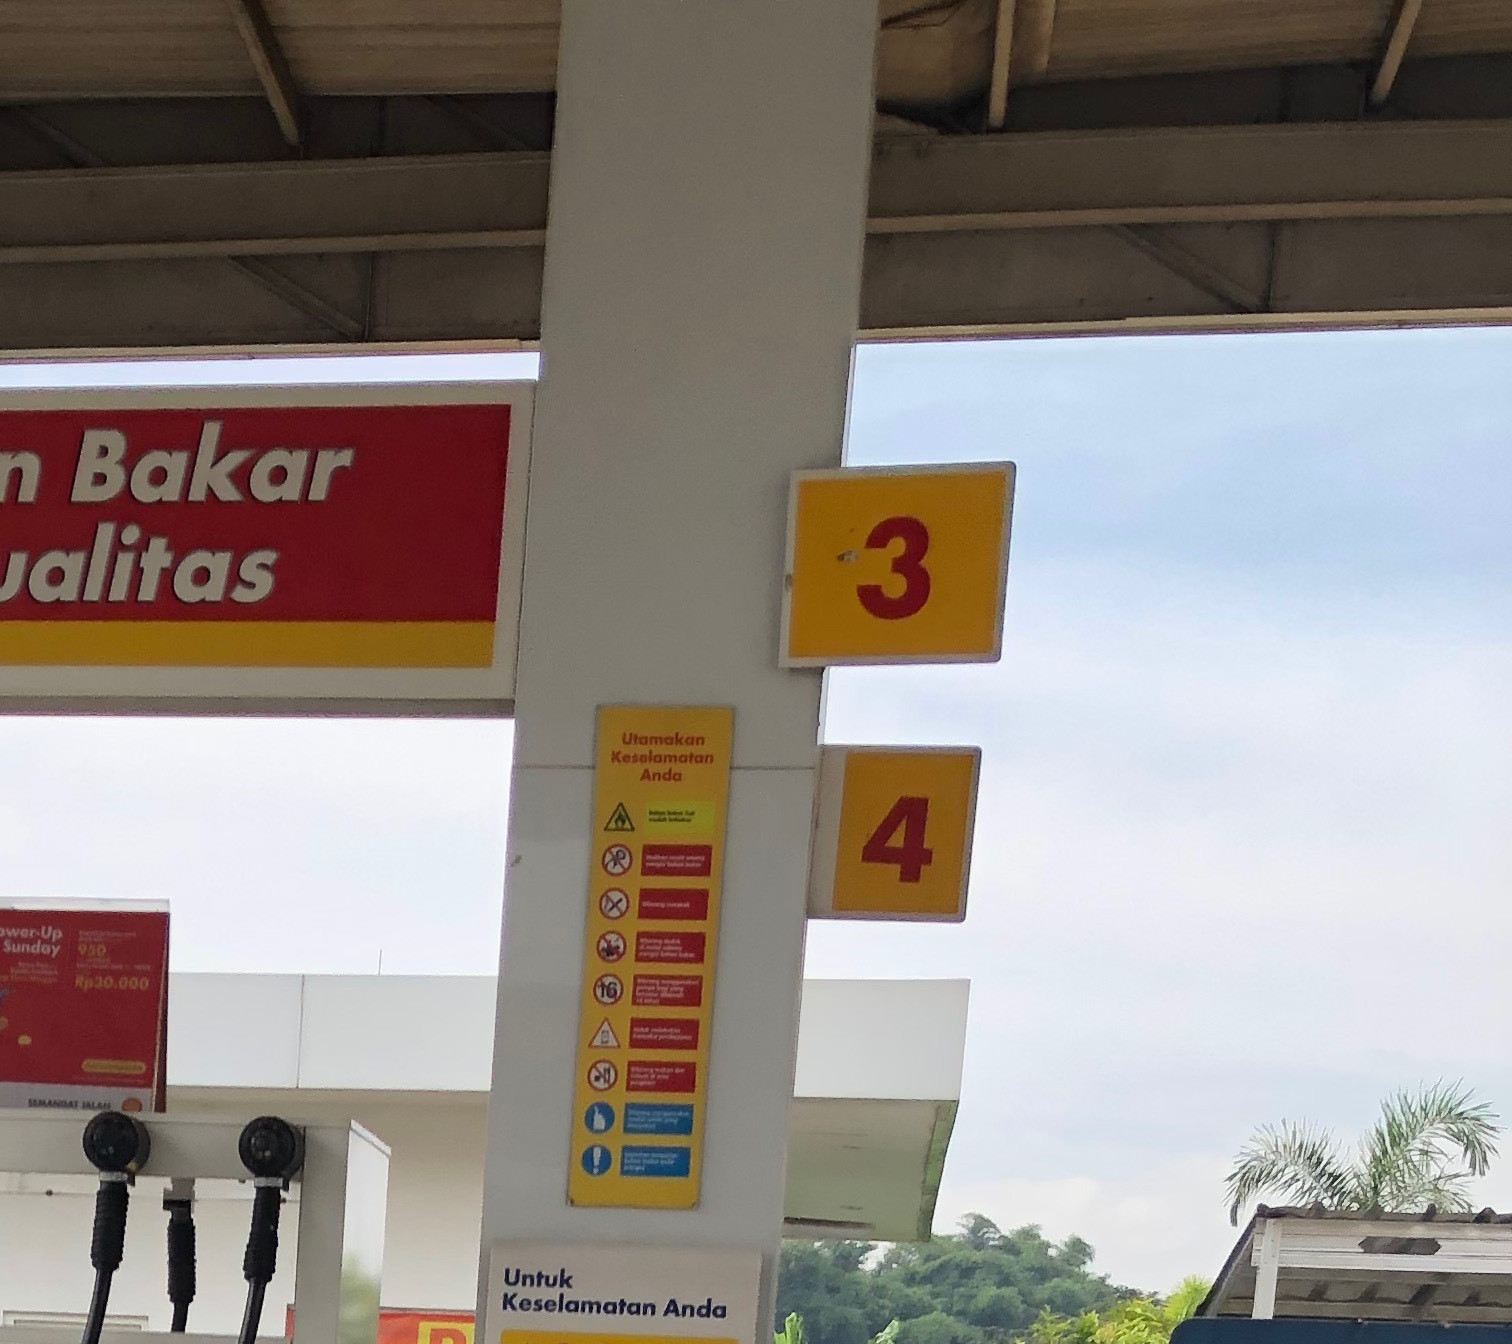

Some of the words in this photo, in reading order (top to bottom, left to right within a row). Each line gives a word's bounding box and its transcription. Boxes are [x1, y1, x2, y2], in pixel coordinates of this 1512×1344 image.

[71, 420, 354, 504] Bakar
[857, 515, 931, 620] 3
[622, 732, 706, 746] Utamakan
[611, 750, 715, 765] Keselamatan
[640, 768, 683, 783] Anda
[861, 796, 934, 883] 4
[3, 938, 61, 957] Sunday
[504, 1267, 573, 1289] Untuk
[501, 1292, 657, 1317] Keselamatan
[663, 1298, 728, 1319] Anda
